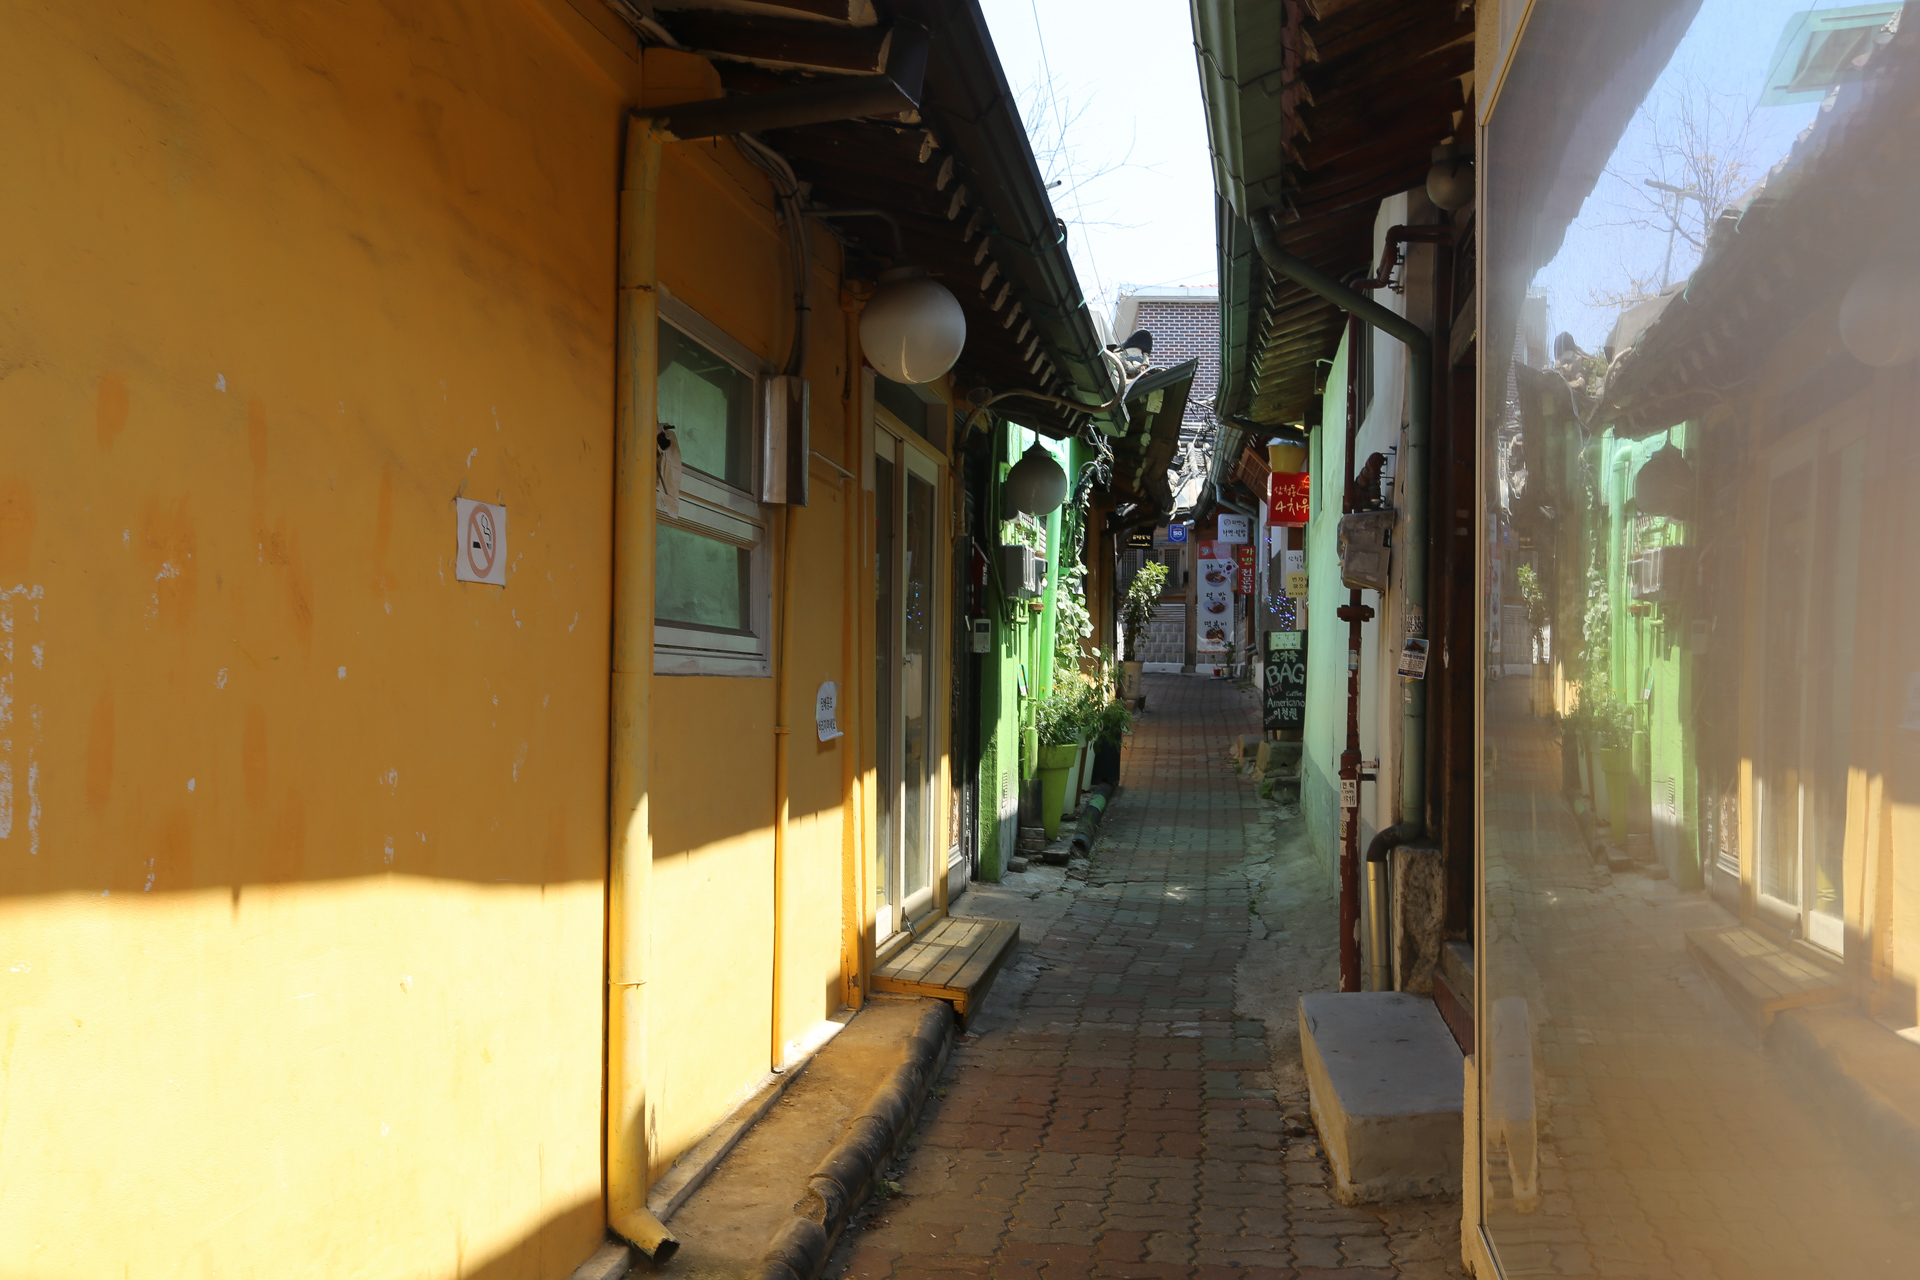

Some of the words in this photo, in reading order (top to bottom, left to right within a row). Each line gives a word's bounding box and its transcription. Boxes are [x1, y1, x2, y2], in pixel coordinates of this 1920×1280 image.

[1241, 547, 1254, 566] 가방
[1241, 568, 1253, 594] 전문점
[1271, 650, 1298, 663] 소가죽
[1265, 663, 1305, 686] BAG
[1267, 684, 1283, 696] HOT
[1267, 698, 1306, 708] Americano
